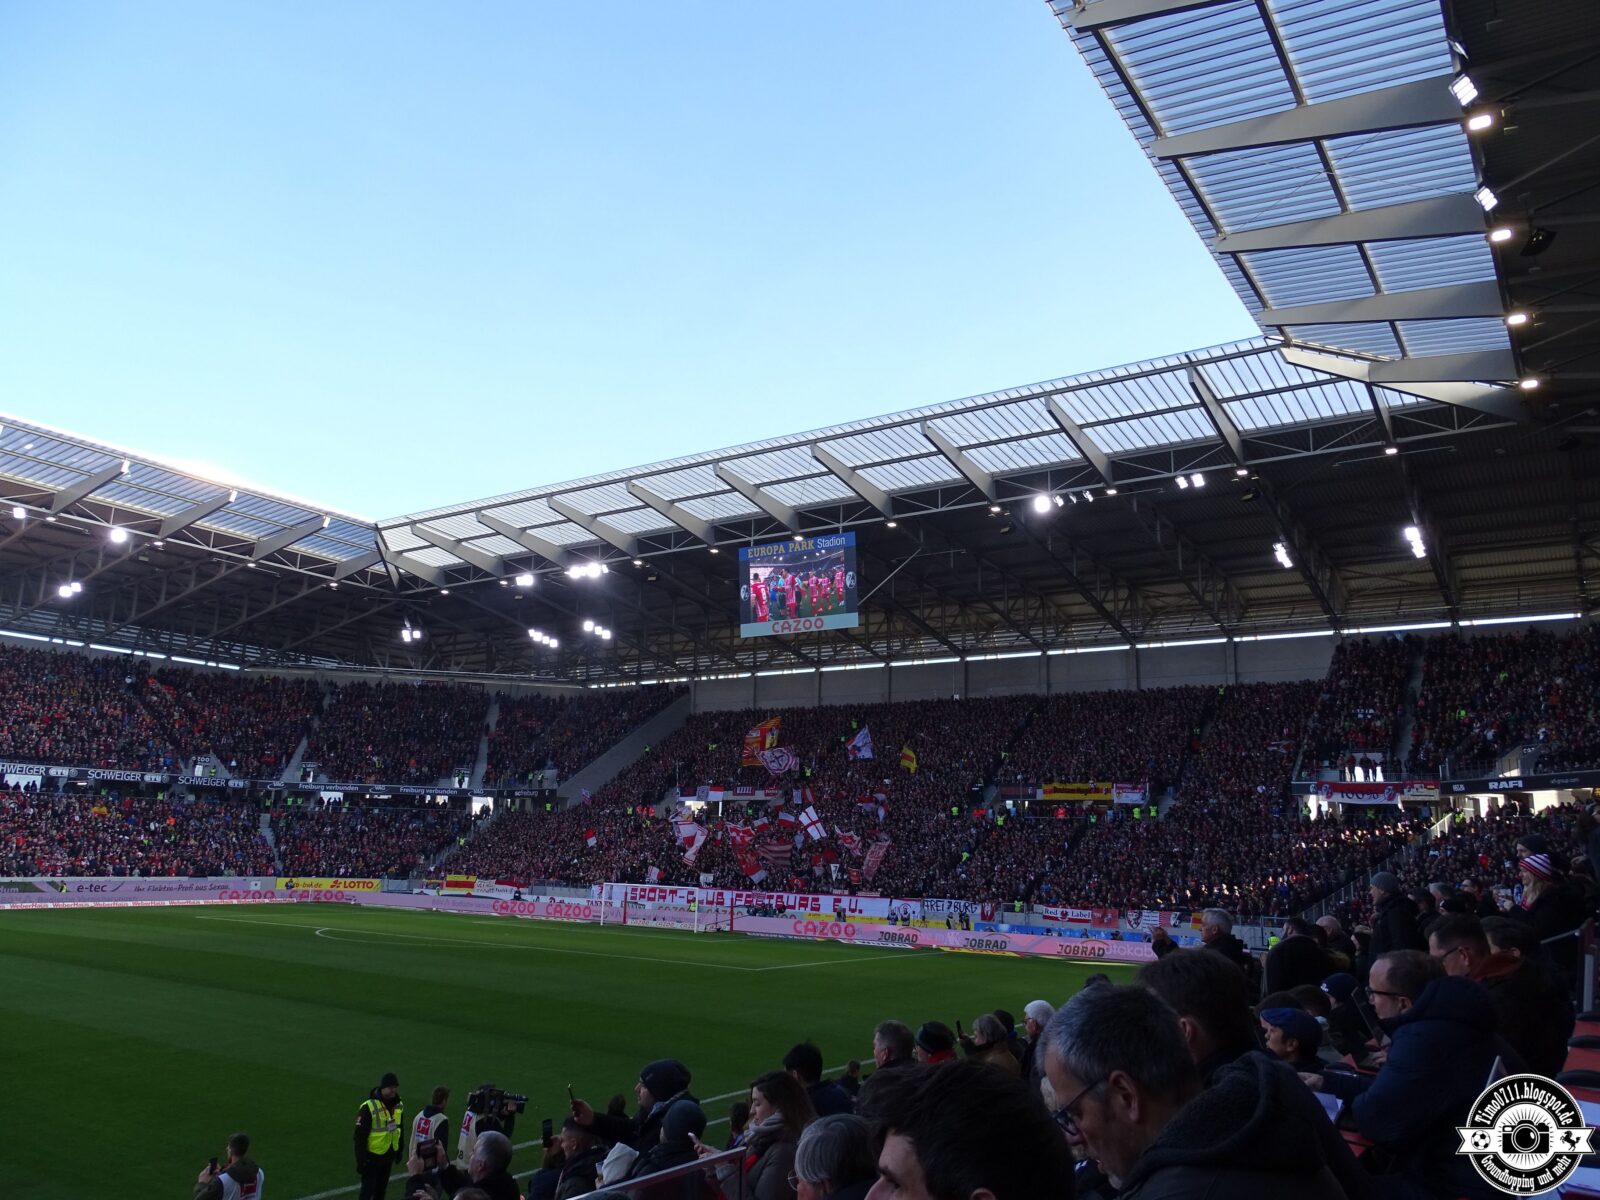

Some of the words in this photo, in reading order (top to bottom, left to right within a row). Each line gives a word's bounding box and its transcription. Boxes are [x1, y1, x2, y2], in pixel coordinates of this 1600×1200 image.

[747, 544, 786, 559] EUROPA
[788, 540, 814, 553] PARK
[817, 536, 846, 549] Stadion
[771, 617, 824, 634] CAZOO
[87, 769, 142, 781] SCHWEIGER
[178, 776, 225, 787] SCHWEIGER
[298, 783, 325, 791] Freiburg
[1488, 780, 1523, 789] RAFI
[399, 786, 425, 794] Freiburg
[426, 787, 458, 795] verbunden
[76, 883, 108, 892] e-tec
[343, 880, 374, 889] LOTTO
[219, 889, 276, 900] CAZOO
[289, 889, 344, 901] CAZOO
[492, 900, 536, 915] CAZOO
[545, 903, 592, 918] CAZOO
[1044, 908, 1058, 916] Red
[1071, 911, 1090, 919] Label
[793, 920, 856, 938] CAZOO
[878, 931, 918, 943] JOBRAD
[963, 937, 1007, 950] JOBRAD
[1056, 943, 1105, 957] JOBRAD
